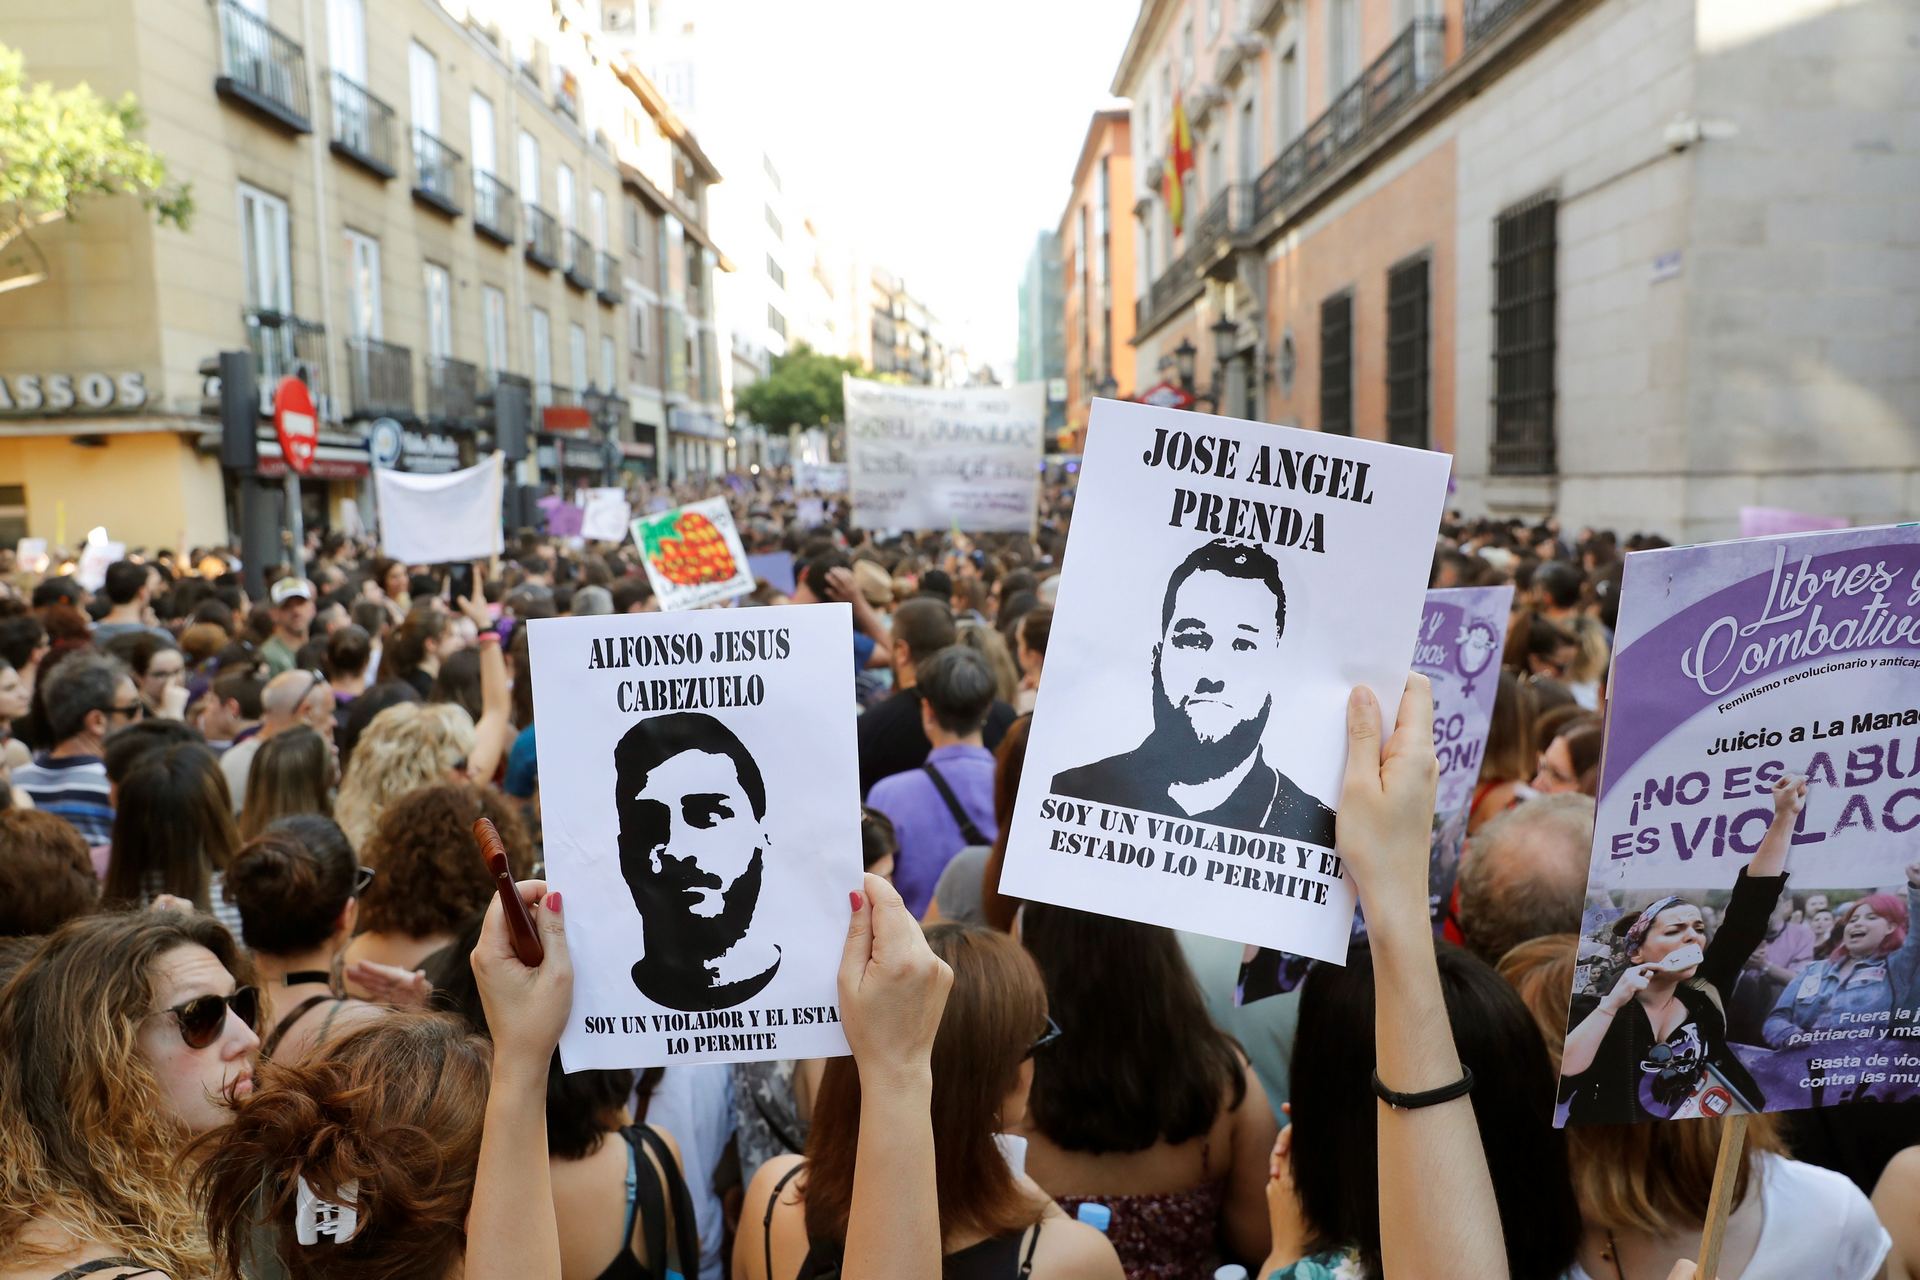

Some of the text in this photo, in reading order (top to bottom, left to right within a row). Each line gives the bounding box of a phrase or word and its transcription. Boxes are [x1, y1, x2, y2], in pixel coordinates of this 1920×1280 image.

[1143, 428, 1374, 505] JOSE ANGEL
[1168, 488, 1326, 553] PRENDA
[1739, 545, 1904, 636] Libres
[588, 628, 790, 670] ALFONSO JESUS
[617, 674, 765, 713] CABEZUELO
[1718, 681, 1781, 714] Feminismo
[1783, 657, 1867, 685] revolucionario
[1870, 659, 1878, 669] y
[1707, 709, 1920, 756] Juicio a La Mana
[1629, 771, 1710, 826] ¡NO
[1723, 760, 1785, 799] ES
[1039, 799, 1343, 879] SOY UN VIOLADOR Y EL
[1611, 827, 1660, 860] ES
[1049, 829, 1330, 906] ESTADO LO PERMITE
[584, 1006, 842, 1034] SOY UN VIOLADOR Y EL ESTA
[1788, 1026, 1875, 1046] patriarcal
[1877, 1028, 1890, 1041] y
[1840, 1010, 1891, 1023] Fuera
[1895, 1008, 1911, 1020] la
[667, 1032, 777, 1055] LO PERMITE
[1810, 1055, 1861, 1070] Basta
[1865, 1053, 1889, 1067] de
[1799, 1073, 1856, 1088] contra
[1860, 1071, 1886, 1084] las
